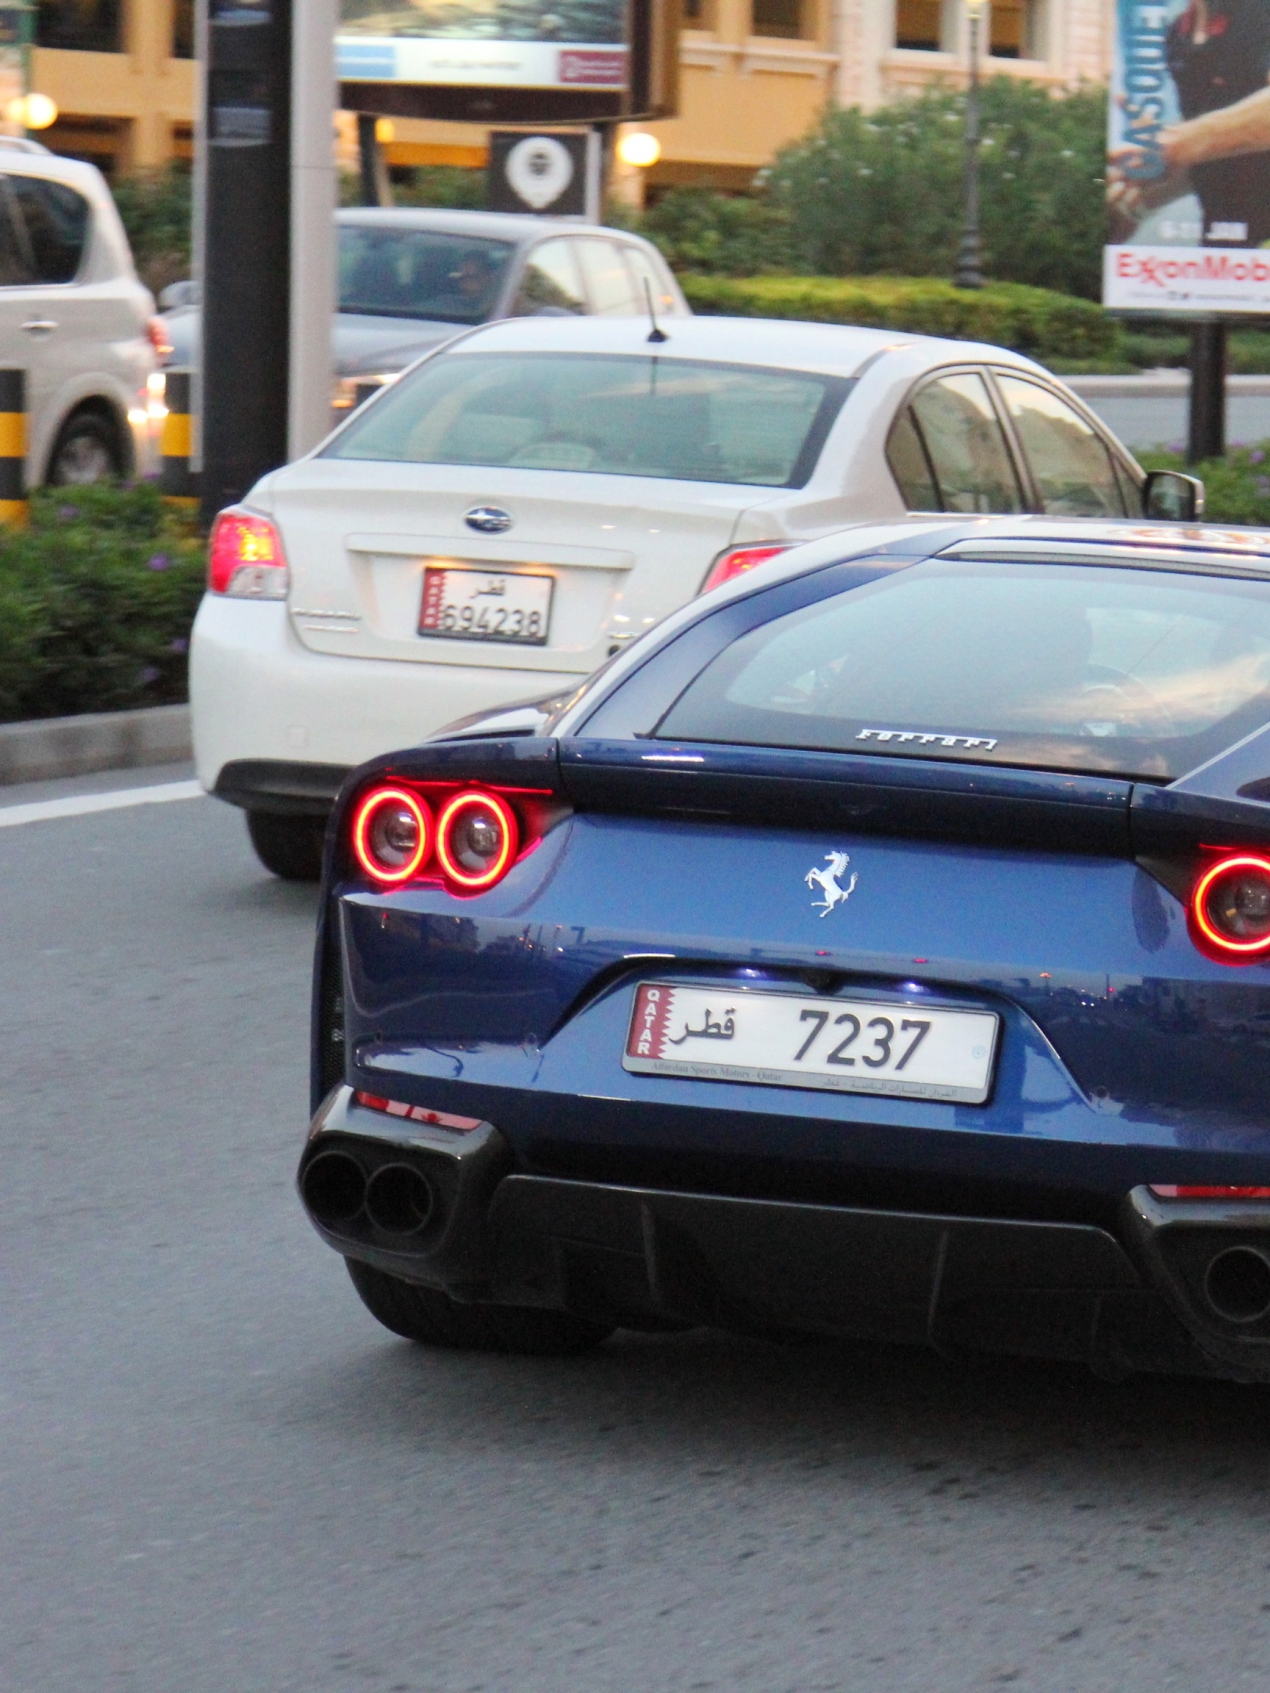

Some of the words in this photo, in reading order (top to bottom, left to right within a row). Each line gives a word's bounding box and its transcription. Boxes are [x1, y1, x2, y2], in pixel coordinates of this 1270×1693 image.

[441, 603, 542, 637] 694238
[855, 729, 998, 752] Ferrari
[637, 988, 661, 1056] QATAR
[668, 1006, 736, 1046] قطر
[793, 1008, 932, 1072] 7237
[651, 1061, 689, 1073] Alfardan
[691, 1065, 718, 1078] Sports
[720, 1067, 751, 1079] Motors
[756, 1070, 783, 1082] Qatar
